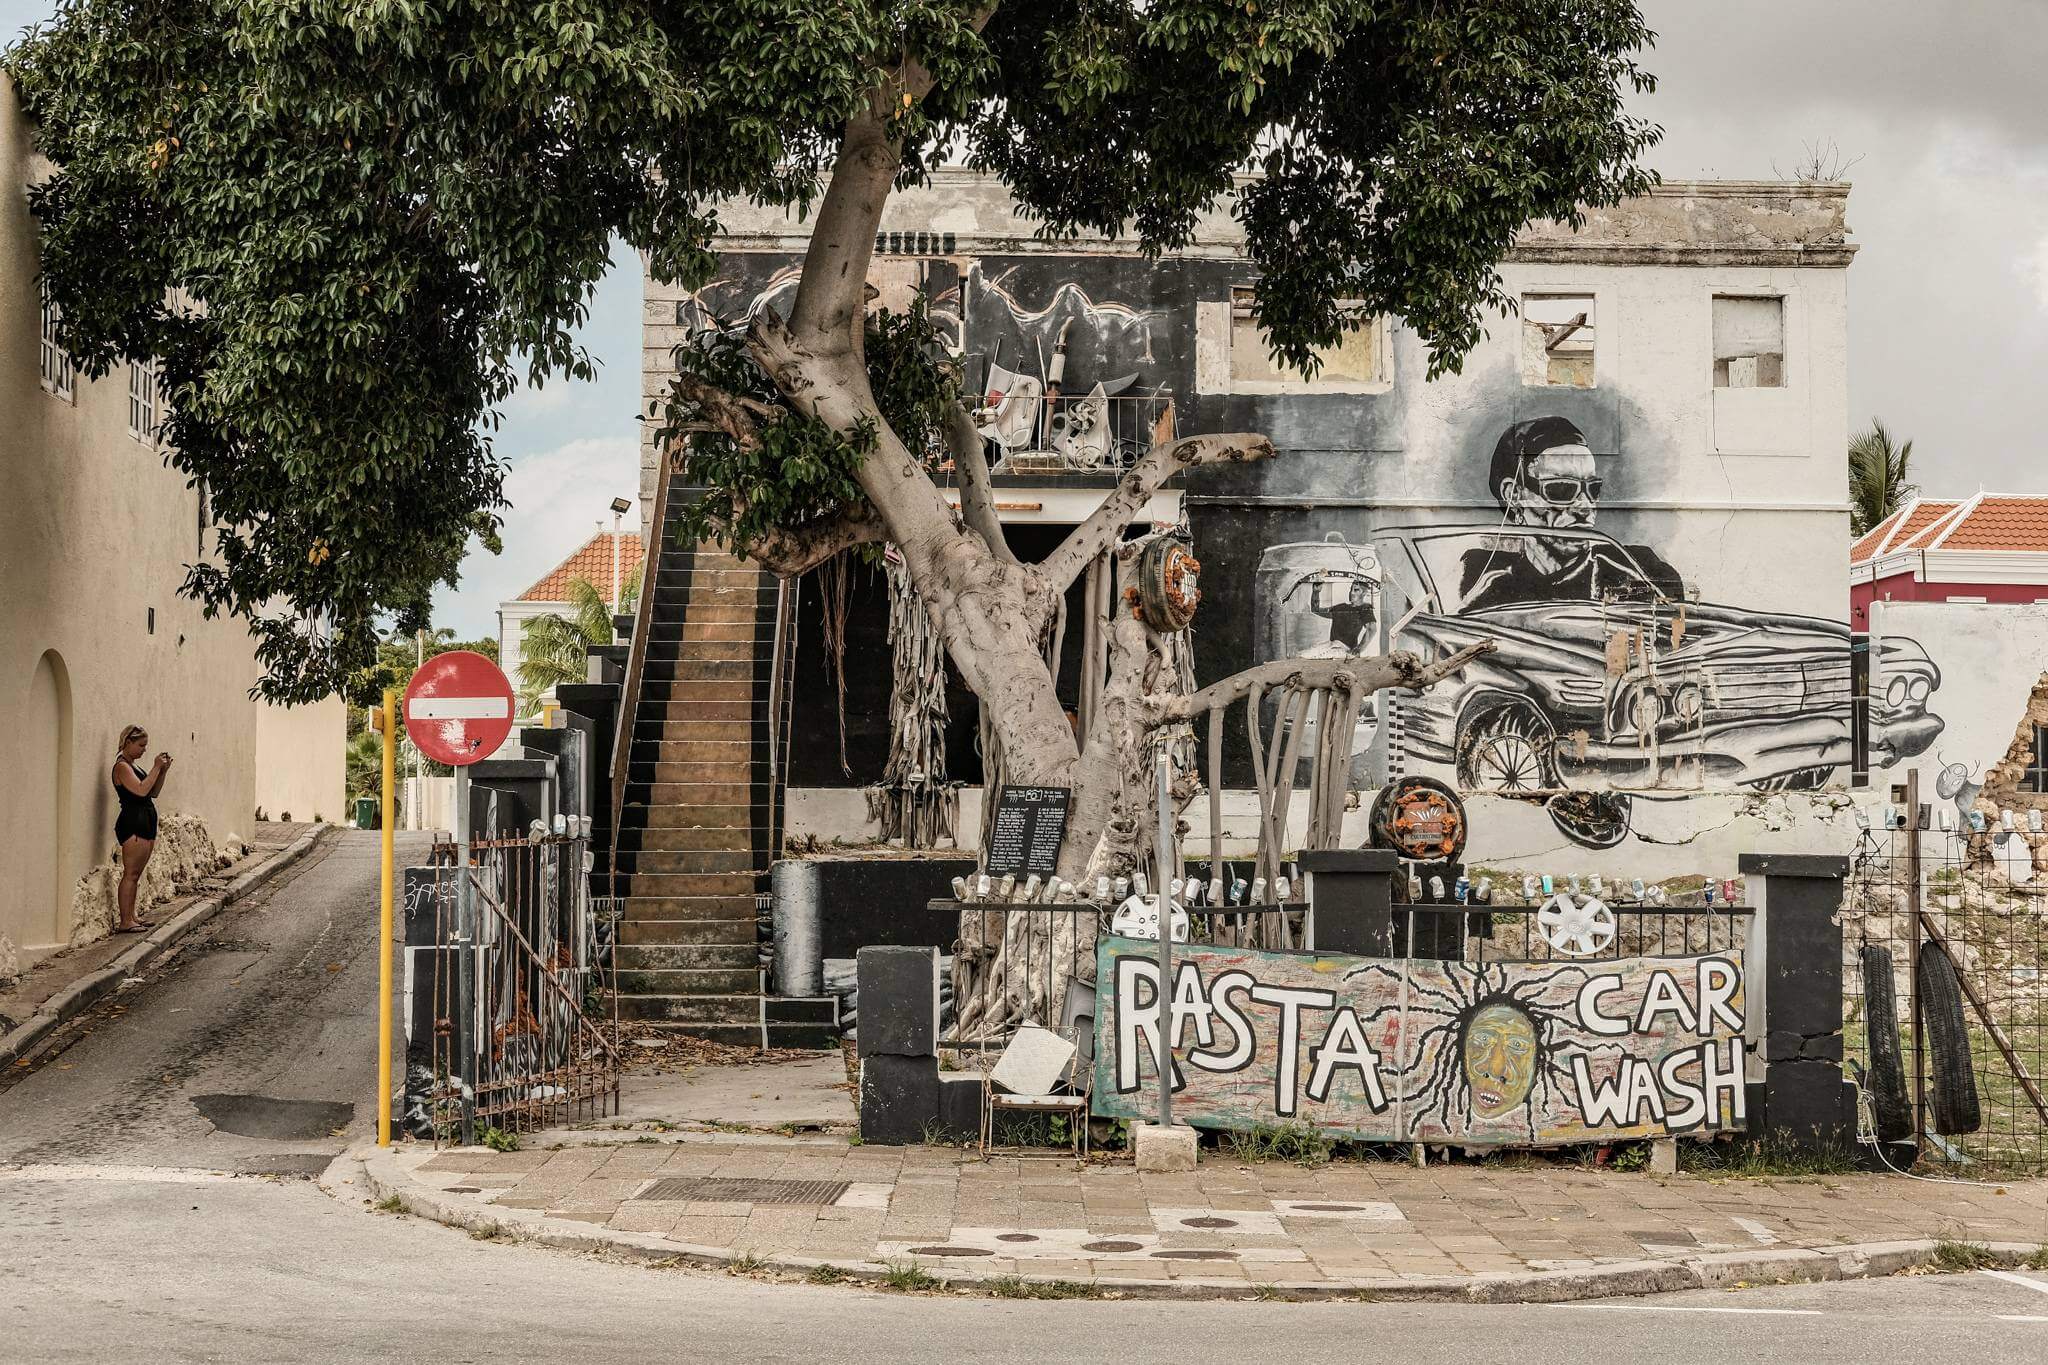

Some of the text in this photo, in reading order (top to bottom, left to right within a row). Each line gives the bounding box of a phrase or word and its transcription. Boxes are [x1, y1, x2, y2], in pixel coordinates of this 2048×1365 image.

[1114, 955, 1389, 1117] RASTA
[1576, 957, 1745, 1037] CAR
[1570, 1035, 1747, 1132] WASH
